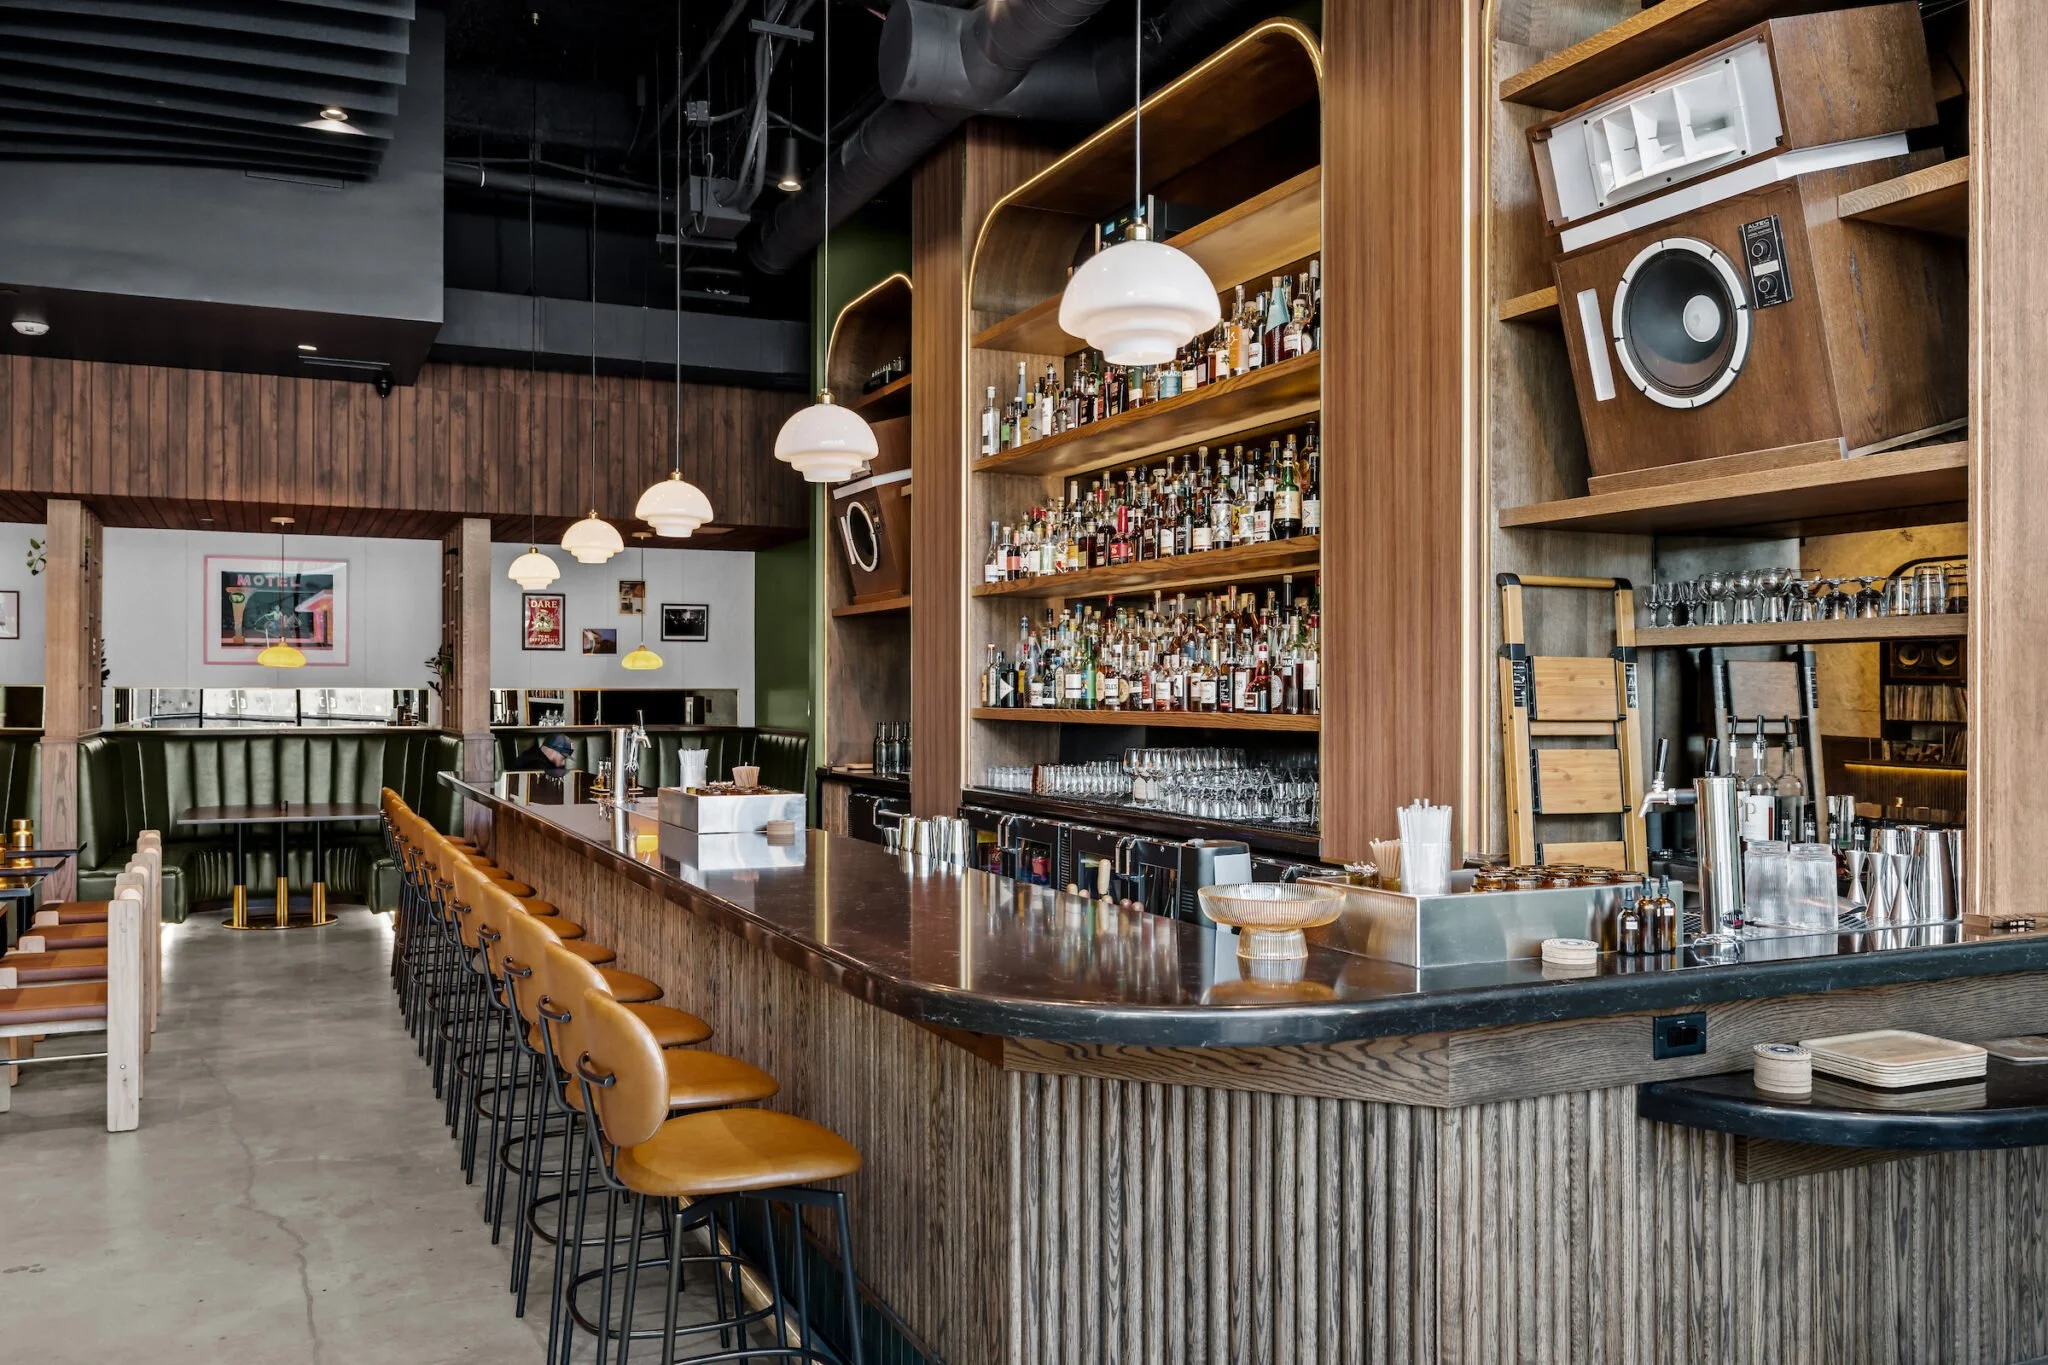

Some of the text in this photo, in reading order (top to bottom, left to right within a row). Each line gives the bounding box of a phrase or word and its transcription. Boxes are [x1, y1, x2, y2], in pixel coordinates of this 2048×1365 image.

[1748, 219, 1769, 229] ALTEC
[236, 574, 301, 587] MOTEL
[531, 600, 557, 608] DARE
